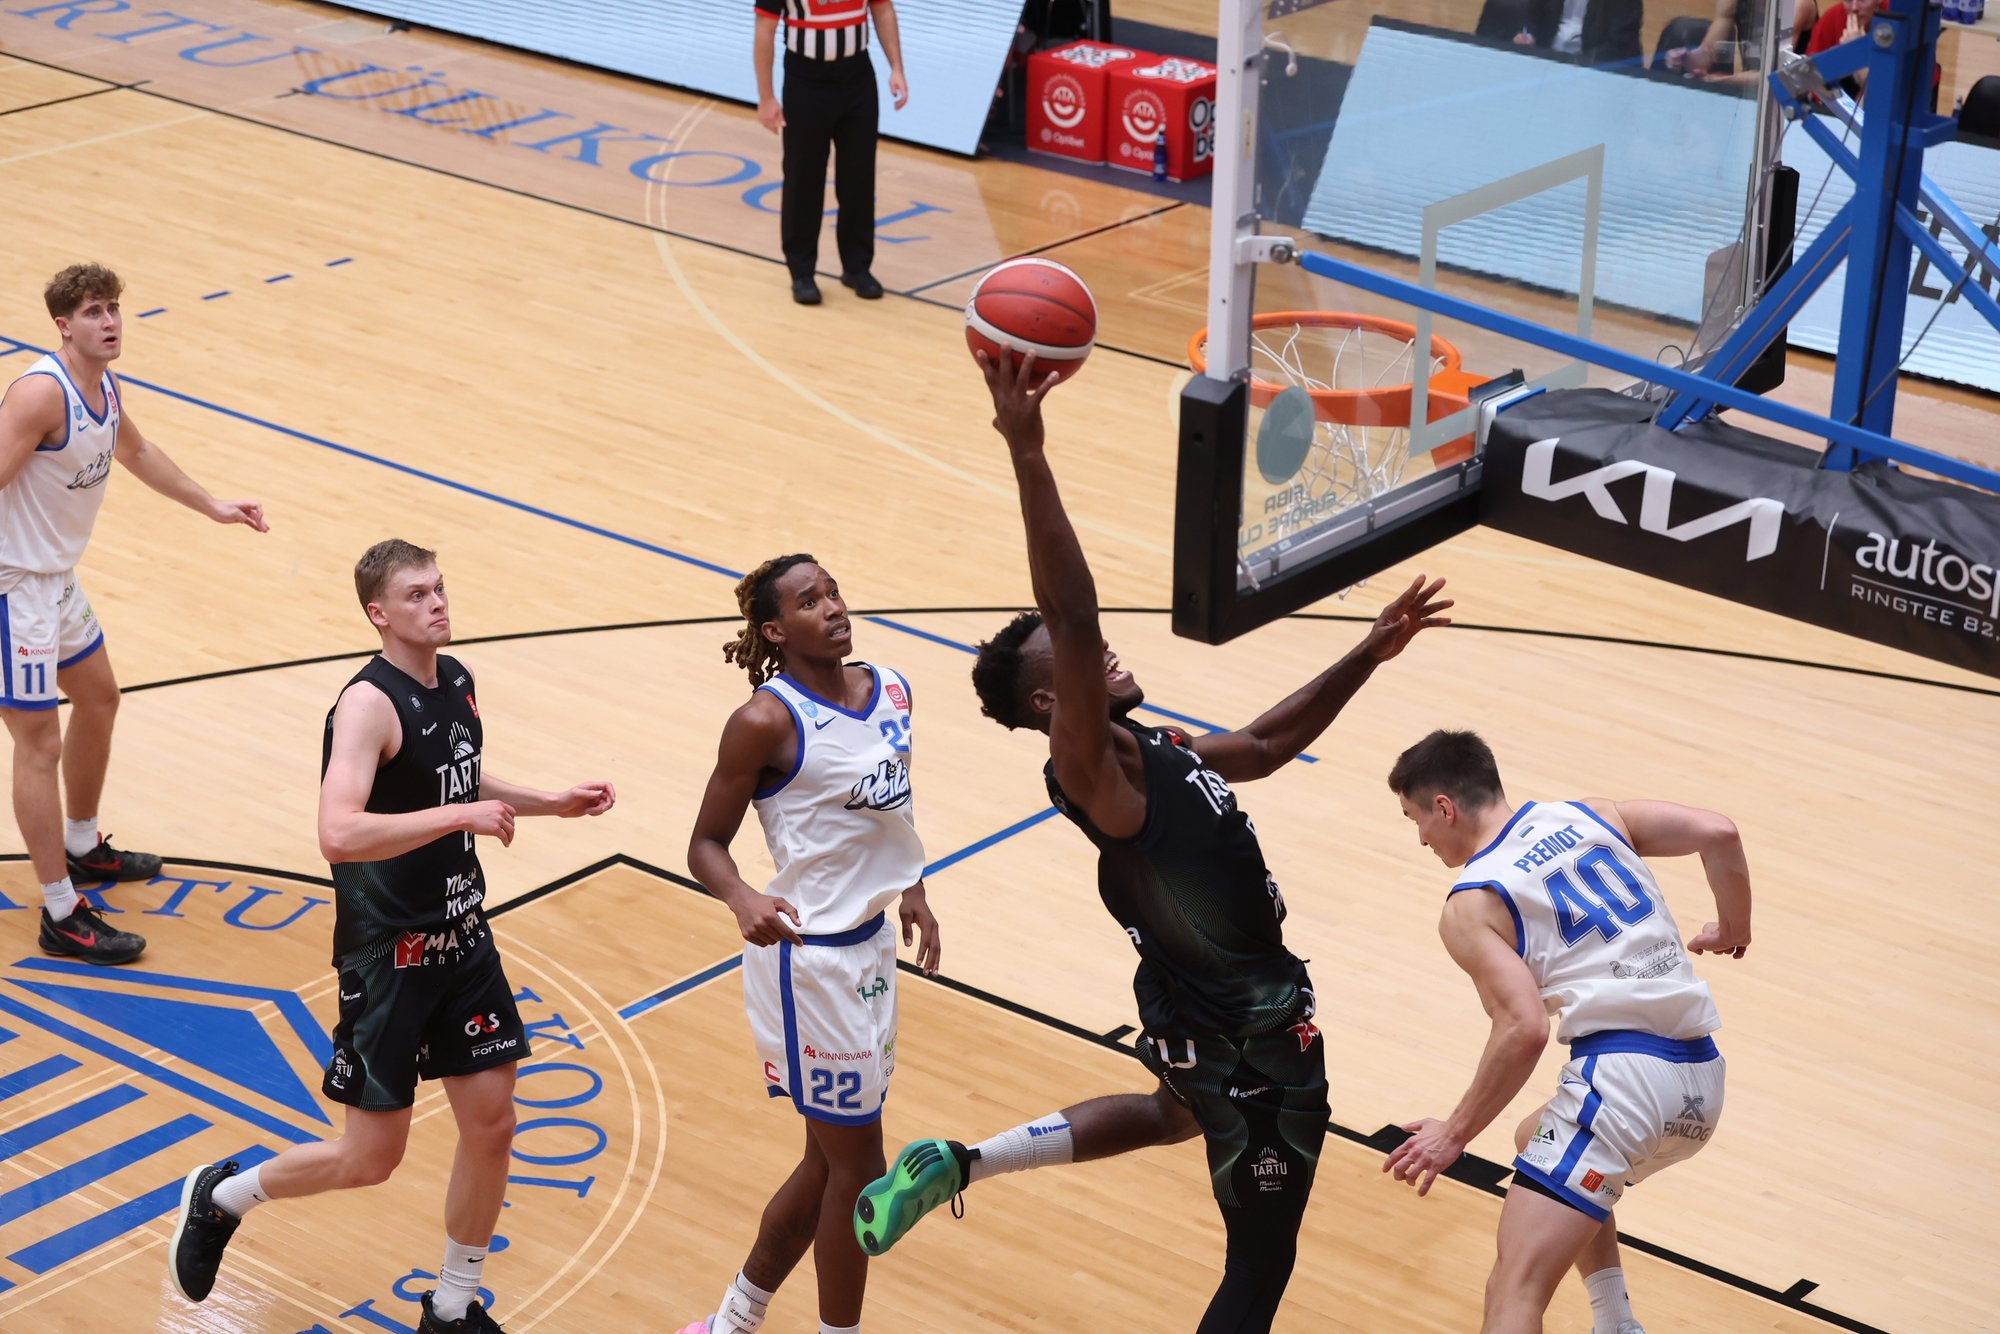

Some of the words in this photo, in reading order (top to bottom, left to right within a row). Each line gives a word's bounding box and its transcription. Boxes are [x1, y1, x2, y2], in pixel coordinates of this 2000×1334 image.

[1851, 583, 1955, 626] RINGTEE
[21, 662, 46, 695] 11
[1513, 824, 1584, 873] PEEMOT
[1542, 843, 1656, 949] 40
[464, 1012, 500, 1037] G4S
[818, 1049, 873, 1061] KINNISVARA
[810, 1067, 862, 1109] 22
[1251, 1161, 1288, 1178] TARTU
